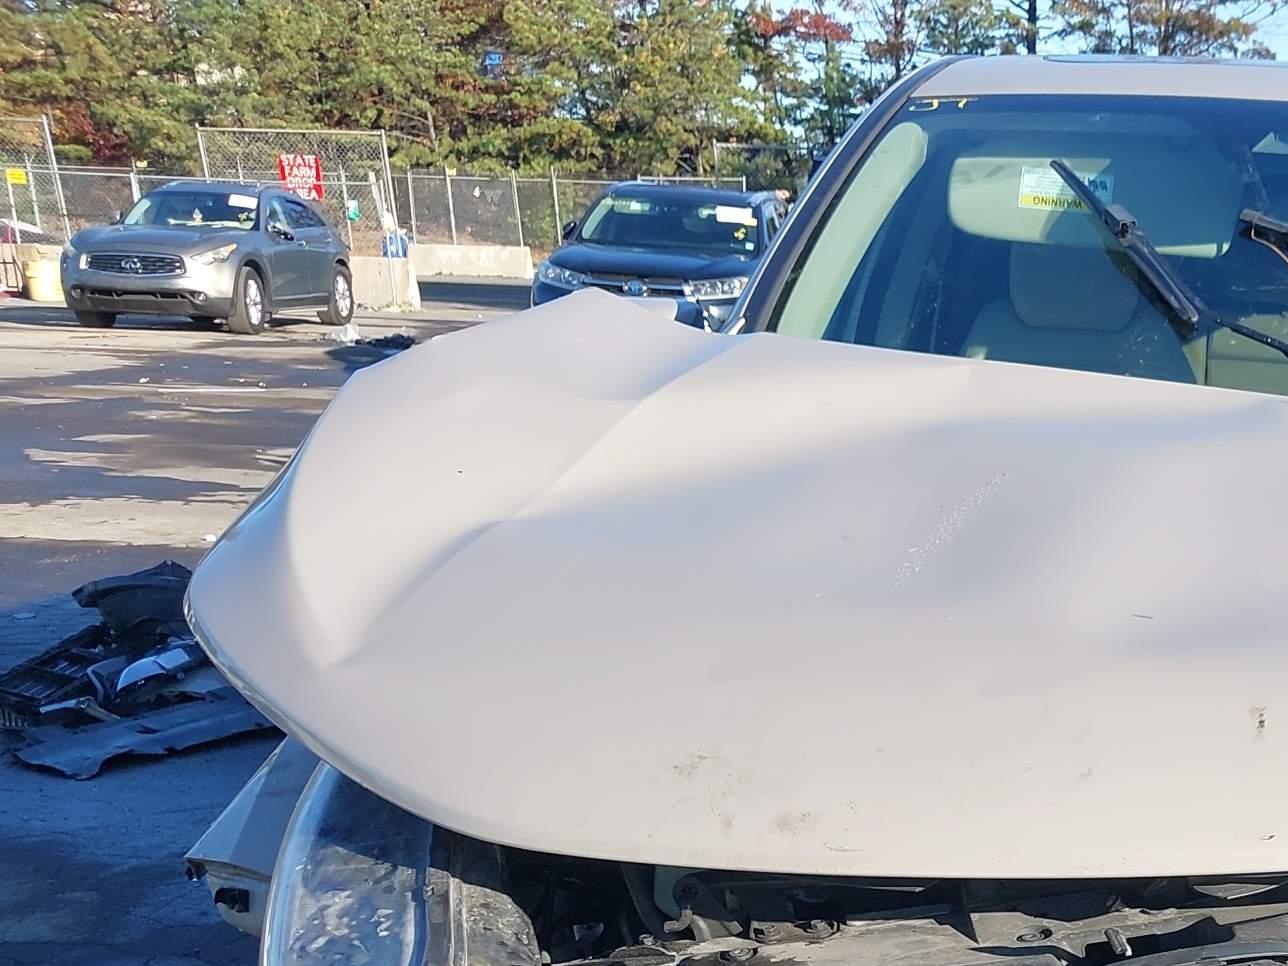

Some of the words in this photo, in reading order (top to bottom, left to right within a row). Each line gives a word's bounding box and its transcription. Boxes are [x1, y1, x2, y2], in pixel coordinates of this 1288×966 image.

[280, 154, 316, 167] STATE
[285, 166, 317, 178] FARM
[287, 177, 316, 189] DROP
[290, 187, 319, 201] REA
[1032, 196, 1083, 209] WARNING
